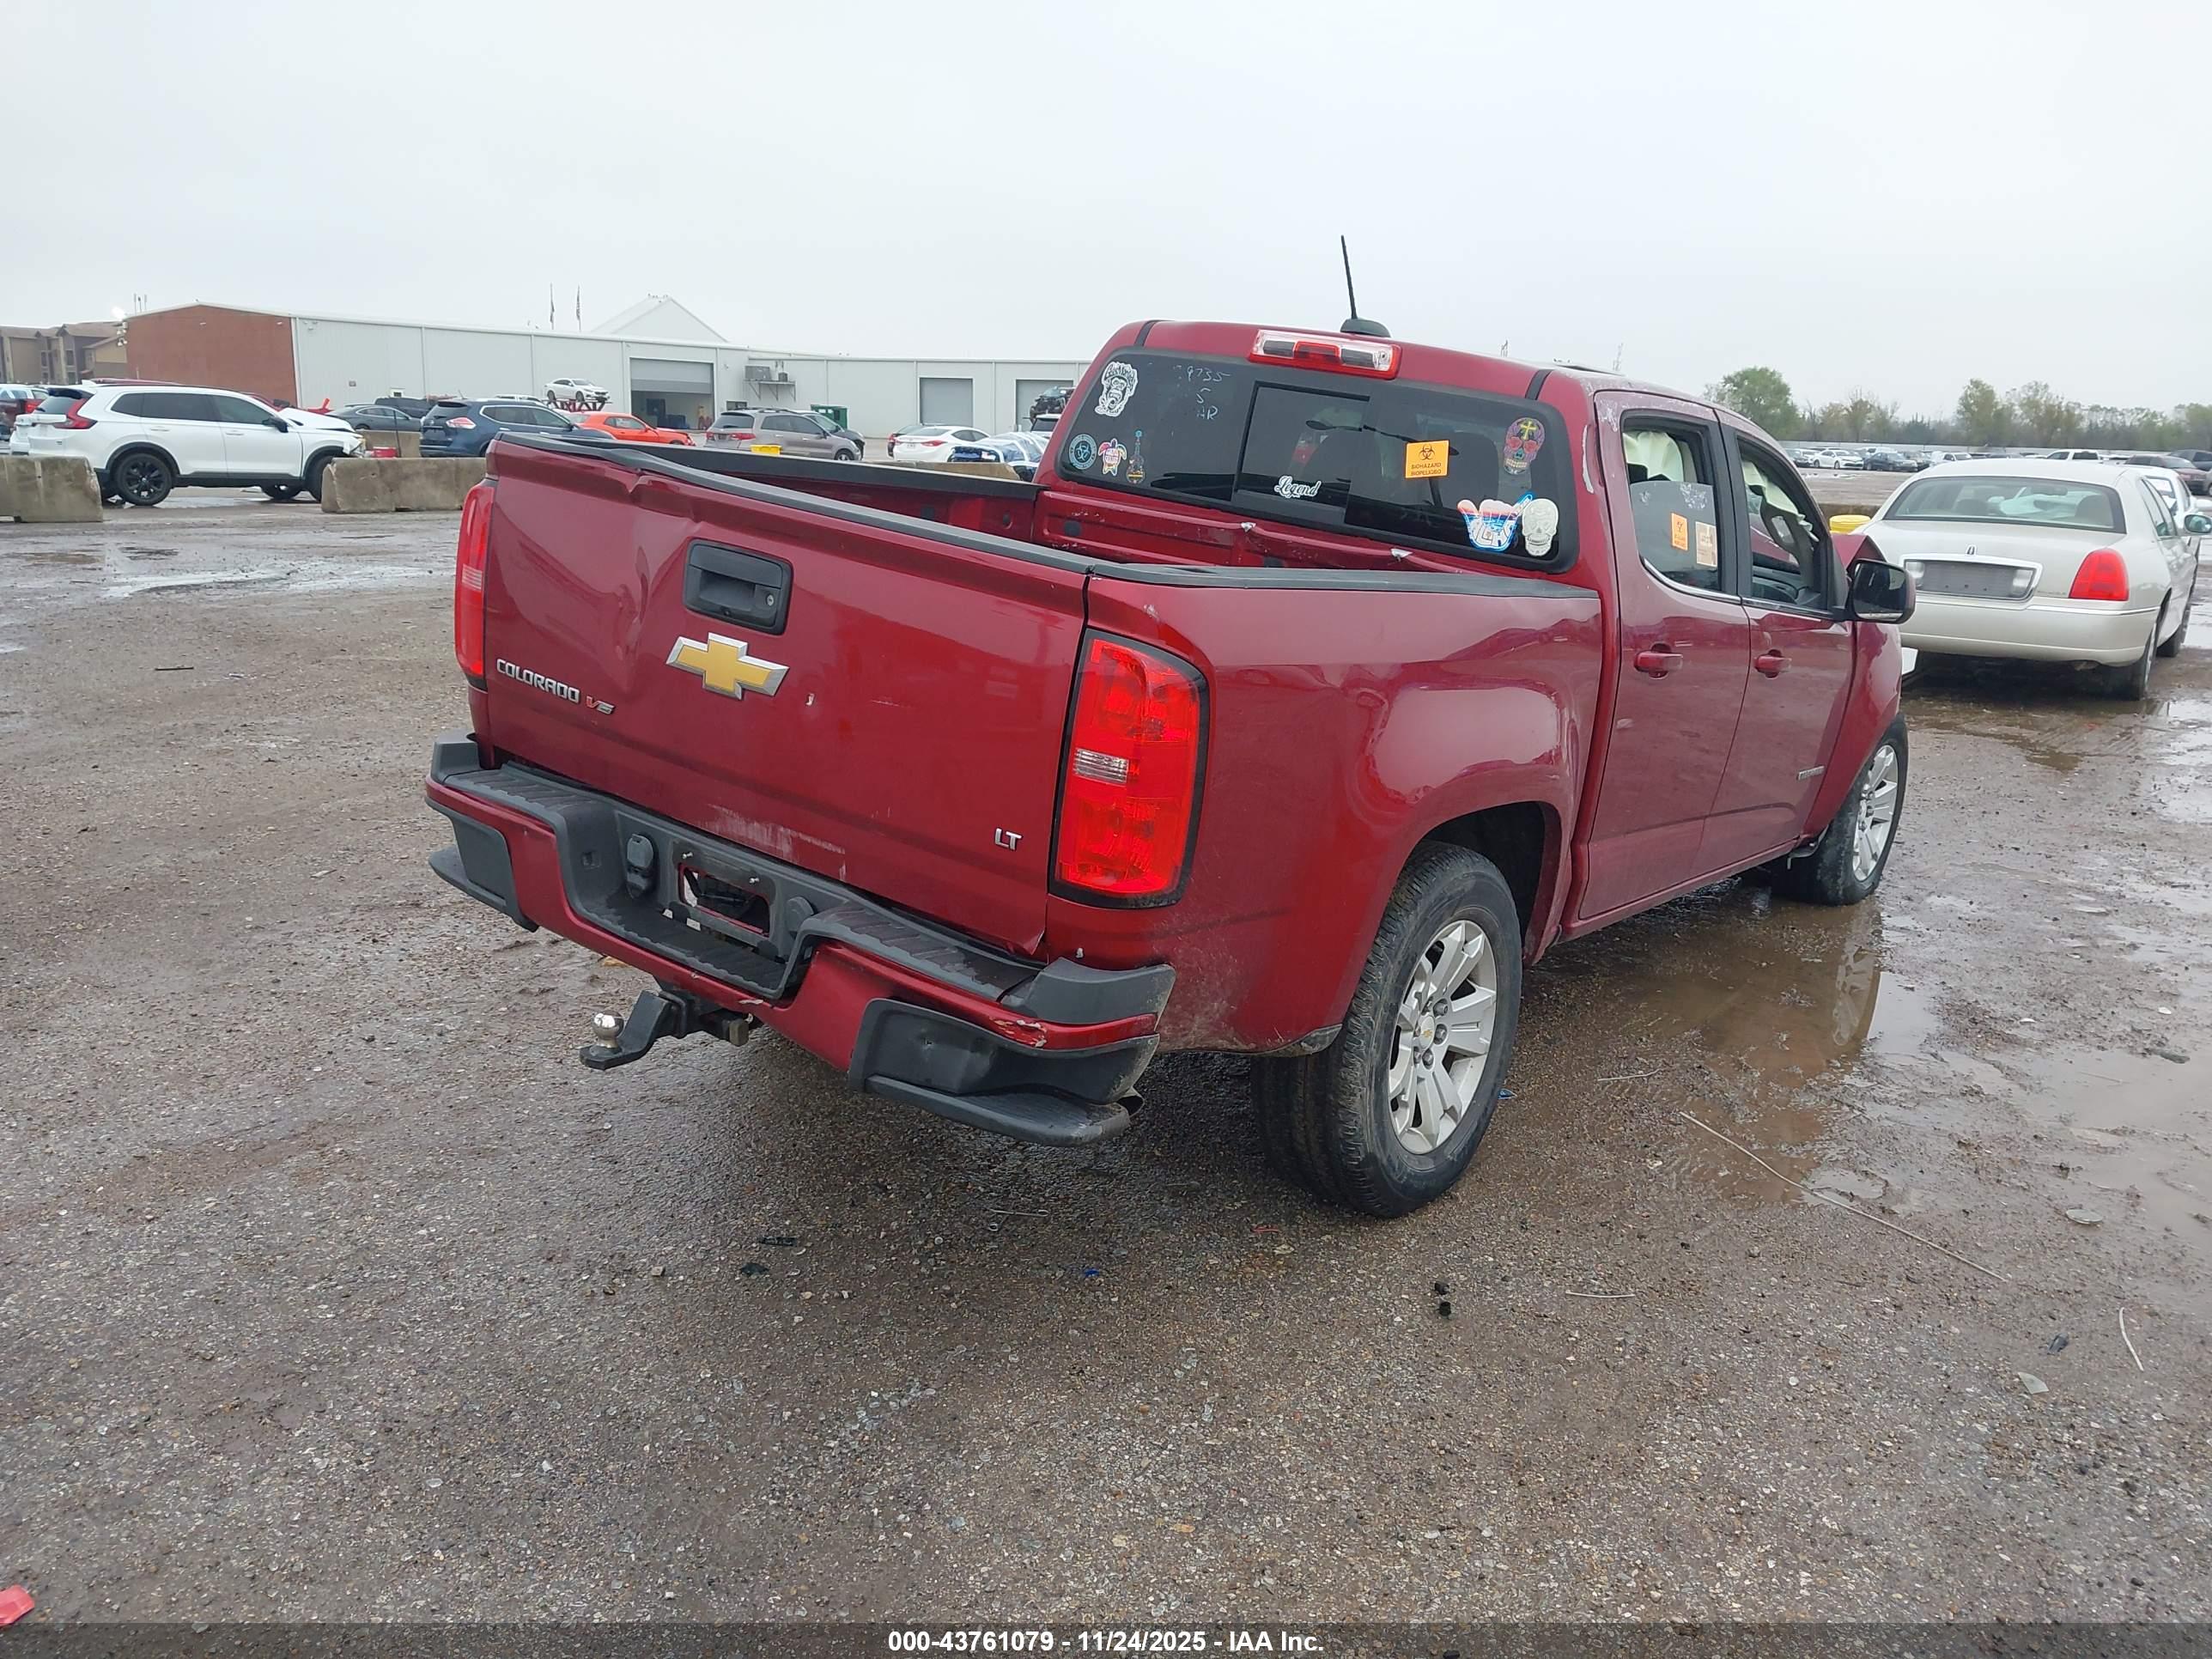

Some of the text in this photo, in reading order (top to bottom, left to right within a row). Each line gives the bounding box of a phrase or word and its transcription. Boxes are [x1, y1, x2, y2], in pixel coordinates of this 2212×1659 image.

[1274, 475, 1322, 498] Legend
[496, 658, 580, 704] COLORADO
[994, 827, 1023, 851] LT
